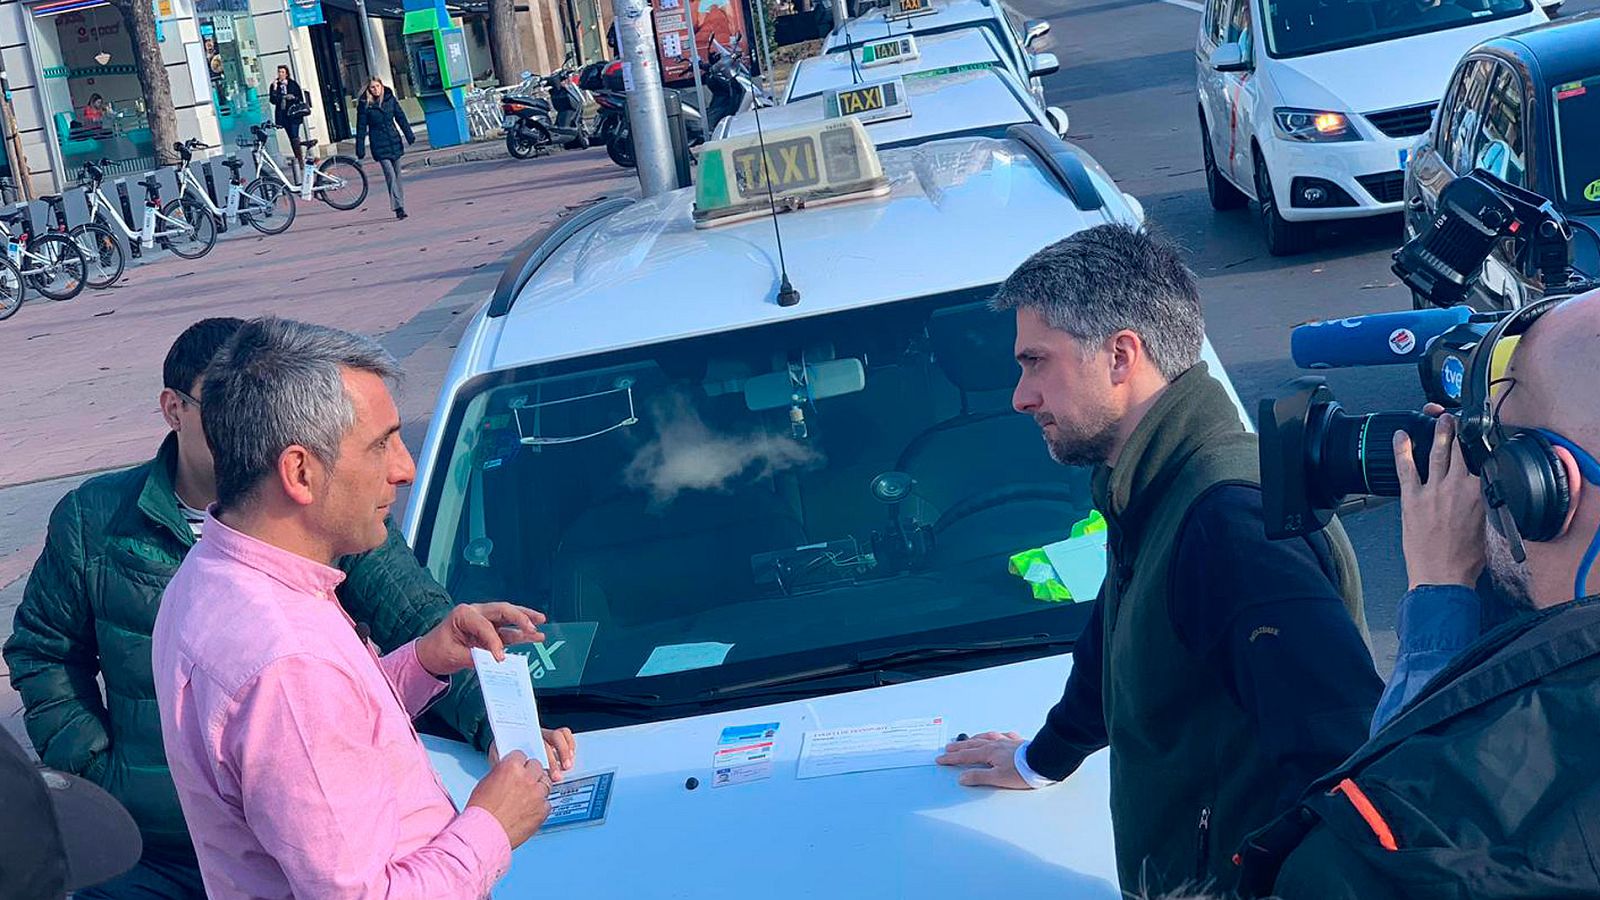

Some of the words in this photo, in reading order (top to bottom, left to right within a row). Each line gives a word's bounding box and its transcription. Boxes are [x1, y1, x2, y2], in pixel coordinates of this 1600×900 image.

[901, 0, 920, 10] TAXI
[876, 41, 900, 59] TAXI
[840, 87, 882, 114] TAXI
[736, 143, 818, 190] TAXI
